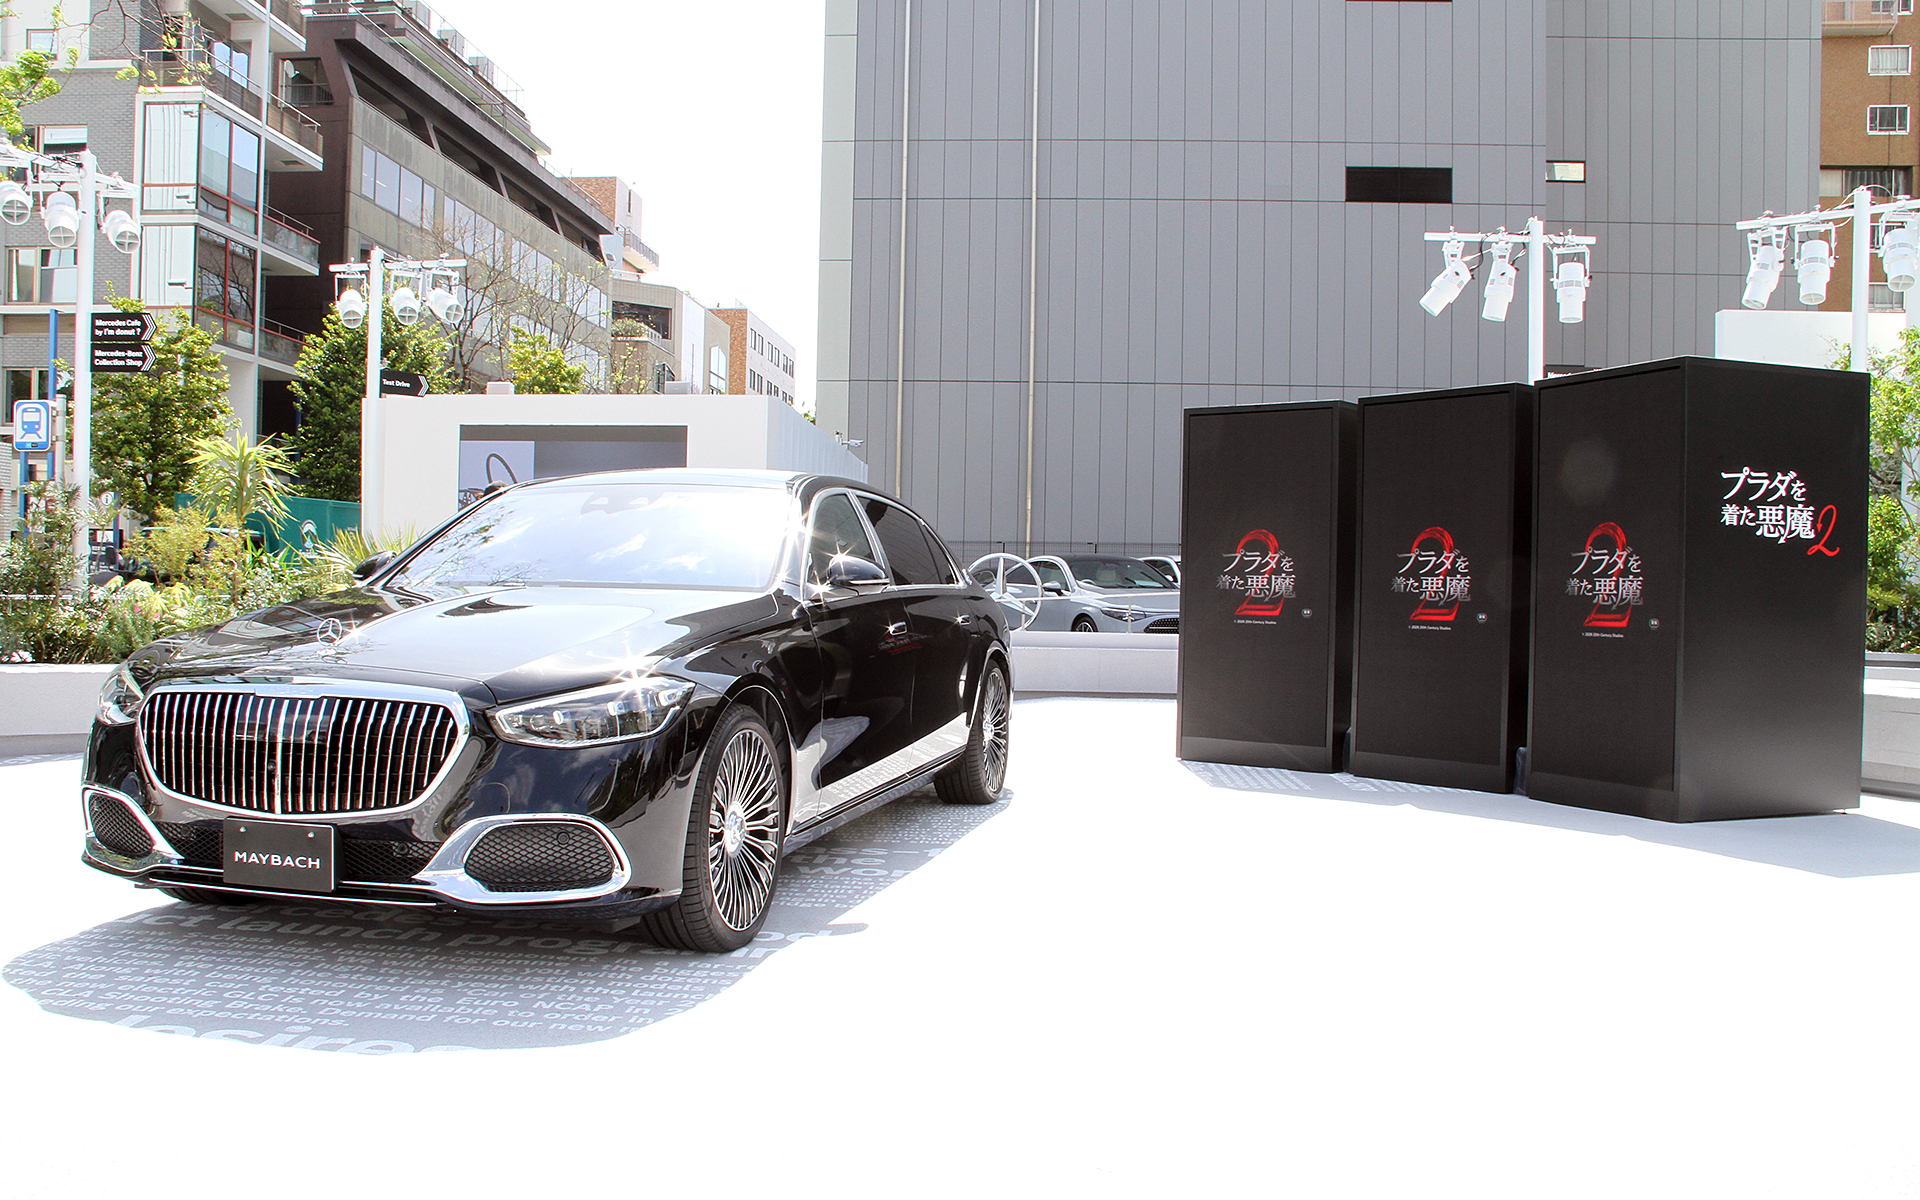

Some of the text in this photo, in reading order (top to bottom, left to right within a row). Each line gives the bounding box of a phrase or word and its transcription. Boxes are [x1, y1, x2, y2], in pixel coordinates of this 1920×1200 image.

[94, 328, 103, 337] by
[103, 328, 114, 336] I'm
[115, 328, 135, 336] donut
[94, 349, 143, 357] Mercedes-Benz
[94, 358, 143, 367] Collection Shop
[1720, 466, 1807, 502] プラダを
[1720, 503, 1840, 557] 着た悪魔 2
[1222, 548, 1294, 573] プラダを
[1396, 548, 1470, 574] プラダを
[1570, 546, 1642, 575] プラダを
[1216, 573, 1297, 602] 着た悪魔
[1390, 574, 1472, 606] 着た悪魔
[1565, 575, 1644, 610] 着た悪魔
[233, 850, 322, 870] MAYBACH
[216, 916, 442, 942] launch
[64, 956, 166, 966] vehicles.
[173, 960, 214, 968] We
[214, 964, 287, 974] made
[290, 968, 334, 978] the
[334, 972, 401, 984] start
[402, 976, 453, 987] last
[451, 980, 514, 990] year
[518, 984, 578, 993] with
[582, 986, 627, 996] the
[112, 949, 172, 960] from
[314, 962, 434, 976] high-tech
[606, 980, 706, 992] models
[336, 956, 376, 964] We
[382, 960, 428, 968] will
[519, 968, 571, 976] you
[576, 970, 634, 980] with
[61, 972, 106, 980] the
[114, 974, 198, 986] safest
[204, 981, 250, 989] car
[258, 984, 346, 998] tested
[352, 990, 390, 1001] by
[399, 994, 444, 1004] the
[456, 997, 520, 1008] Euro
[532, 1000, 614, 1012] NCAP
[625, 1006, 652, 1015] in
[62, 963, 140, 974] Along
[144, 968, 200, 977] with
[204, 970, 280, 984] being
[280, 976, 412, 992] honoured
[556, 993, 601, 1002] the
[612, 996, 670, 1006] Year
[40, 988, 95, 998] CLA
[98, 992, 222, 1008] Shooting
[225, 1000, 308, 1014] Brake.
[318, 1007, 438, 1022] Demand
[442, 1015, 488, 1025] for
[492, 1019, 544, 1028] our
[548, 1023, 613, 1032] new
[55, 982, 116, 990] new
[117, 984, 218, 998] electric
[223, 990, 280, 1002] GLC
[280, 995, 306, 1004] is
[310, 999, 372, 1008] now
[374, 1003, 499, 1016] available
[507, 1010, 536, 1018] to
[543, 1012, 624, 1023] order
[628, 1016, 656, 1025] in
[114, 1004, 166, 1013] our
[166, 1008, 350, 1026] expectations.
